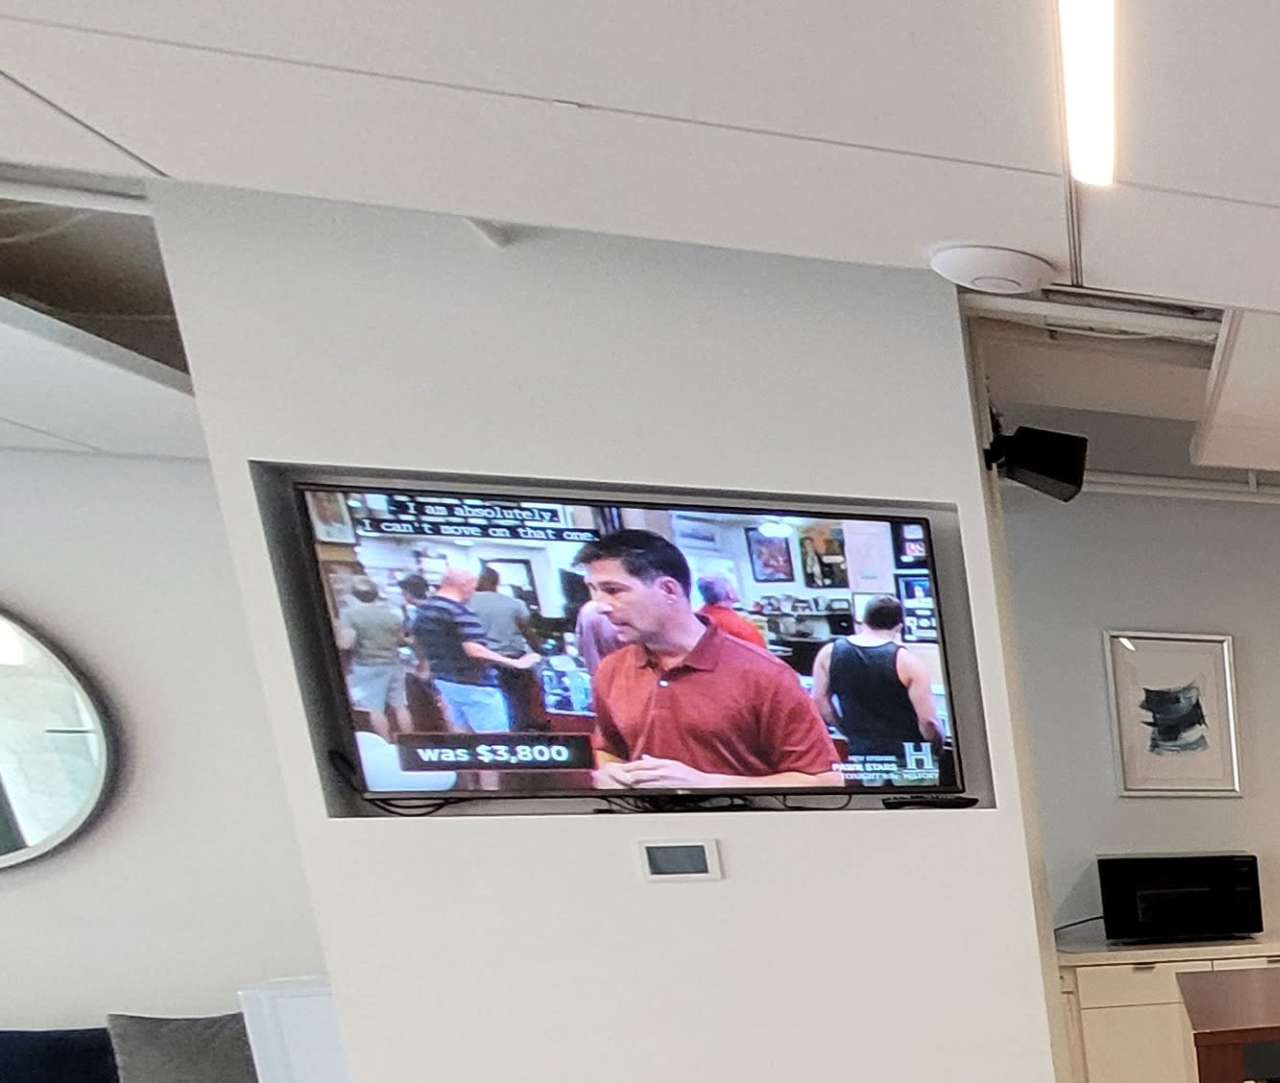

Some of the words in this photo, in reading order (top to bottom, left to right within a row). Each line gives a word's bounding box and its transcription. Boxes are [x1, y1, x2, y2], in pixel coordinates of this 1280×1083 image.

[406, 502, 417, 514] I
[424, 505, 448, 515] am
[453, 505, 559, 522] absolutely.
[362, 519, 373, 531] I
[380, 521, 434, 534] can't
[440, 525, 482, 535] move
[487, 527, 511, 537] on
[516, 527, 557, 540] that
[562, 531, 600, 541] one.
[416, 748, 471, 762] was
[475, 744, 570, 764] $3,800
[902, 741, 934, 769] H
